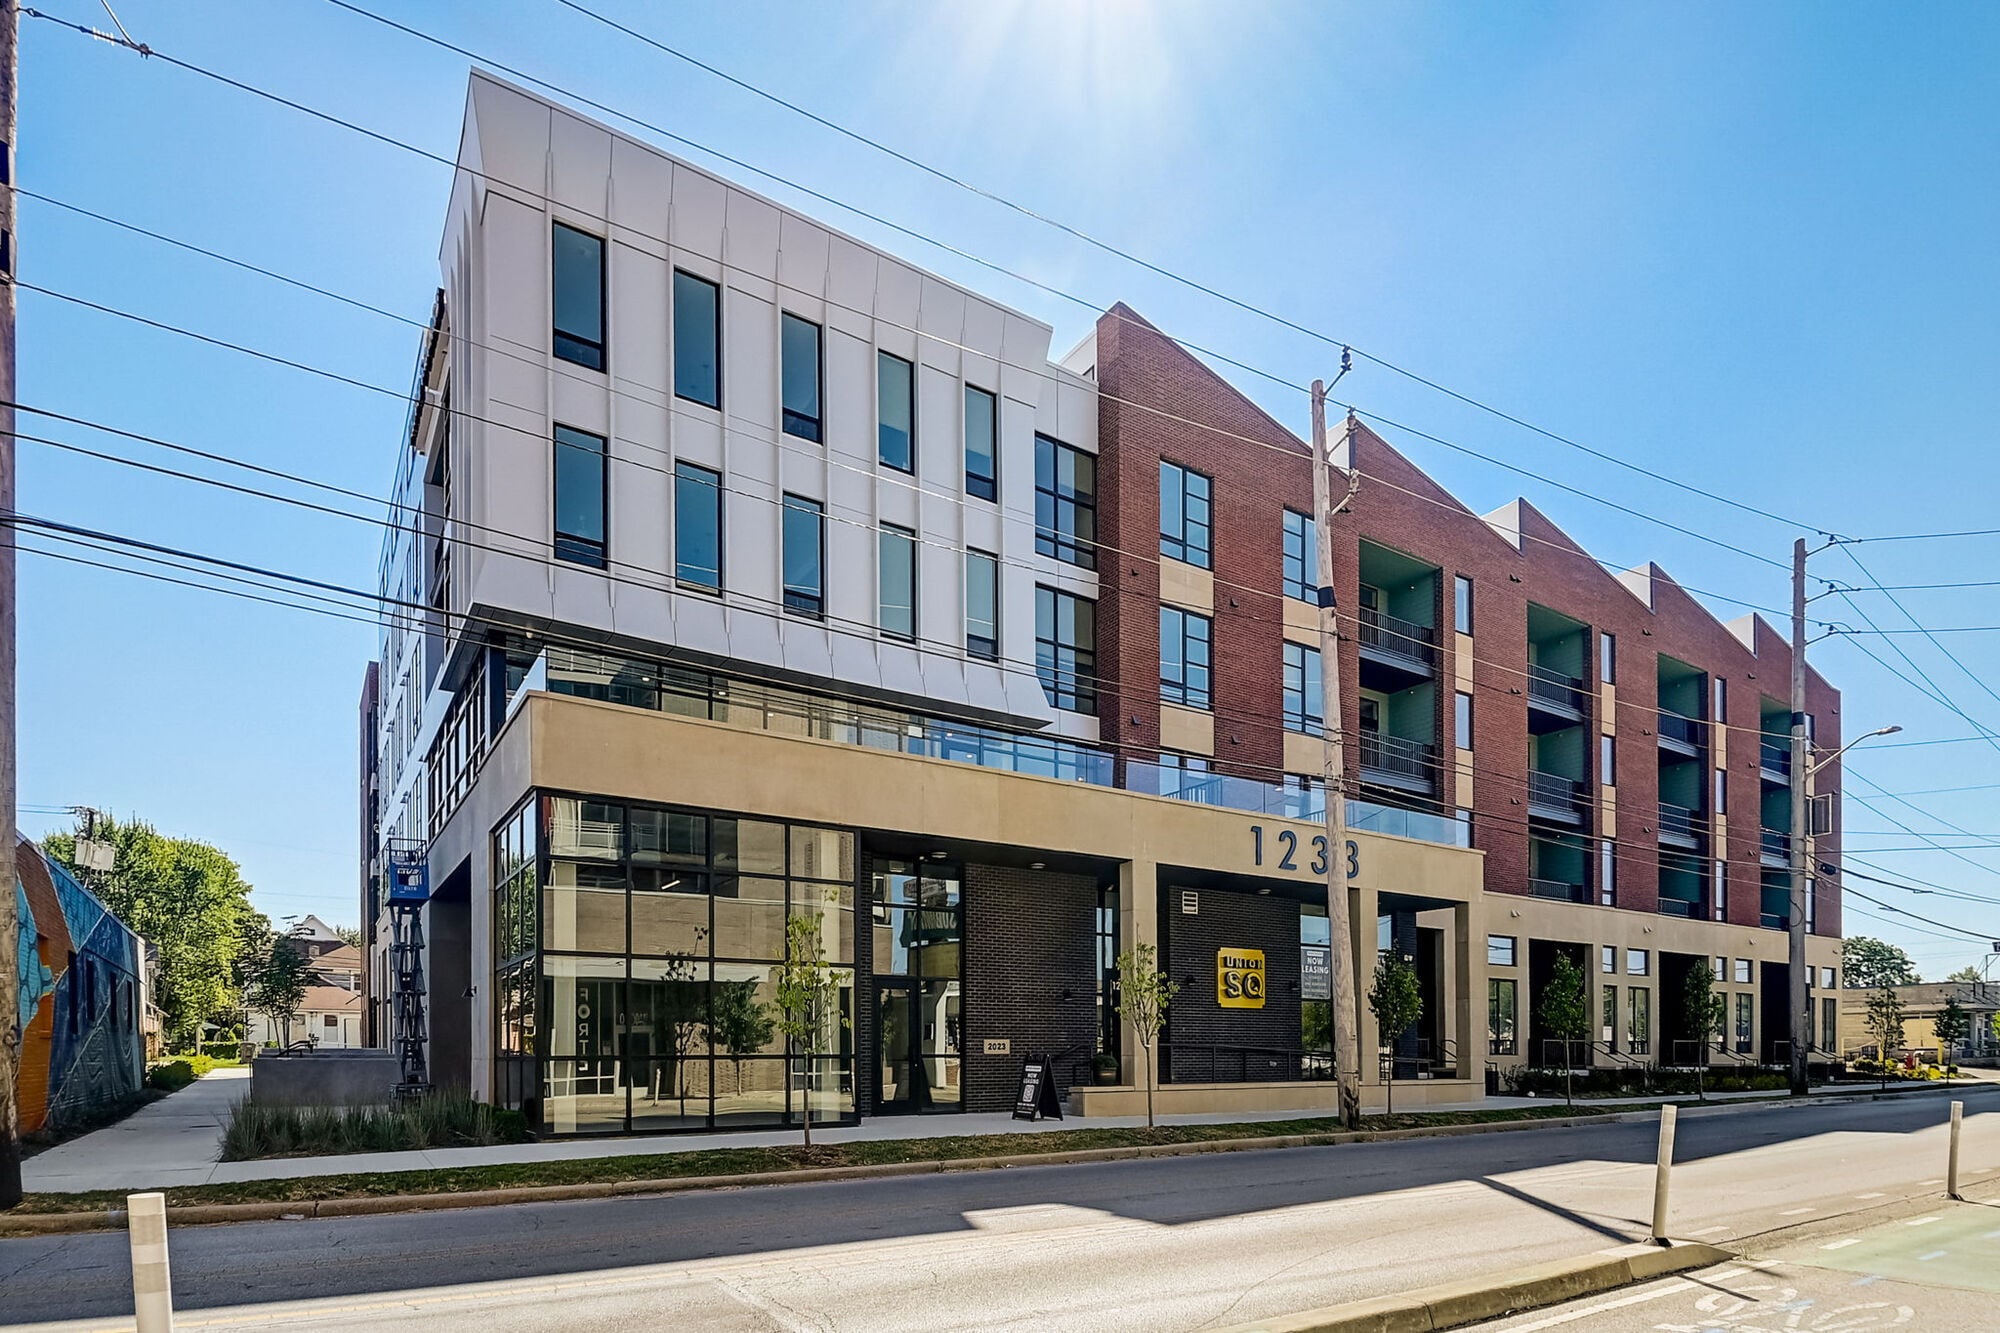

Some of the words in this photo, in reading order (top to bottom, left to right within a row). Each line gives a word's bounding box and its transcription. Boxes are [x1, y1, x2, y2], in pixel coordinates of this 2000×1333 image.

[1250, 826, 1360, 879] 1233
[1224, 956, 1262, 969] UNION
[1306, 957, 1324, 965] NOW
[1301, 965, 1329, 974] LEASING
[1225, 971, 1264, 999] SQ
[988, 1042, 1006, 1050] 2023
